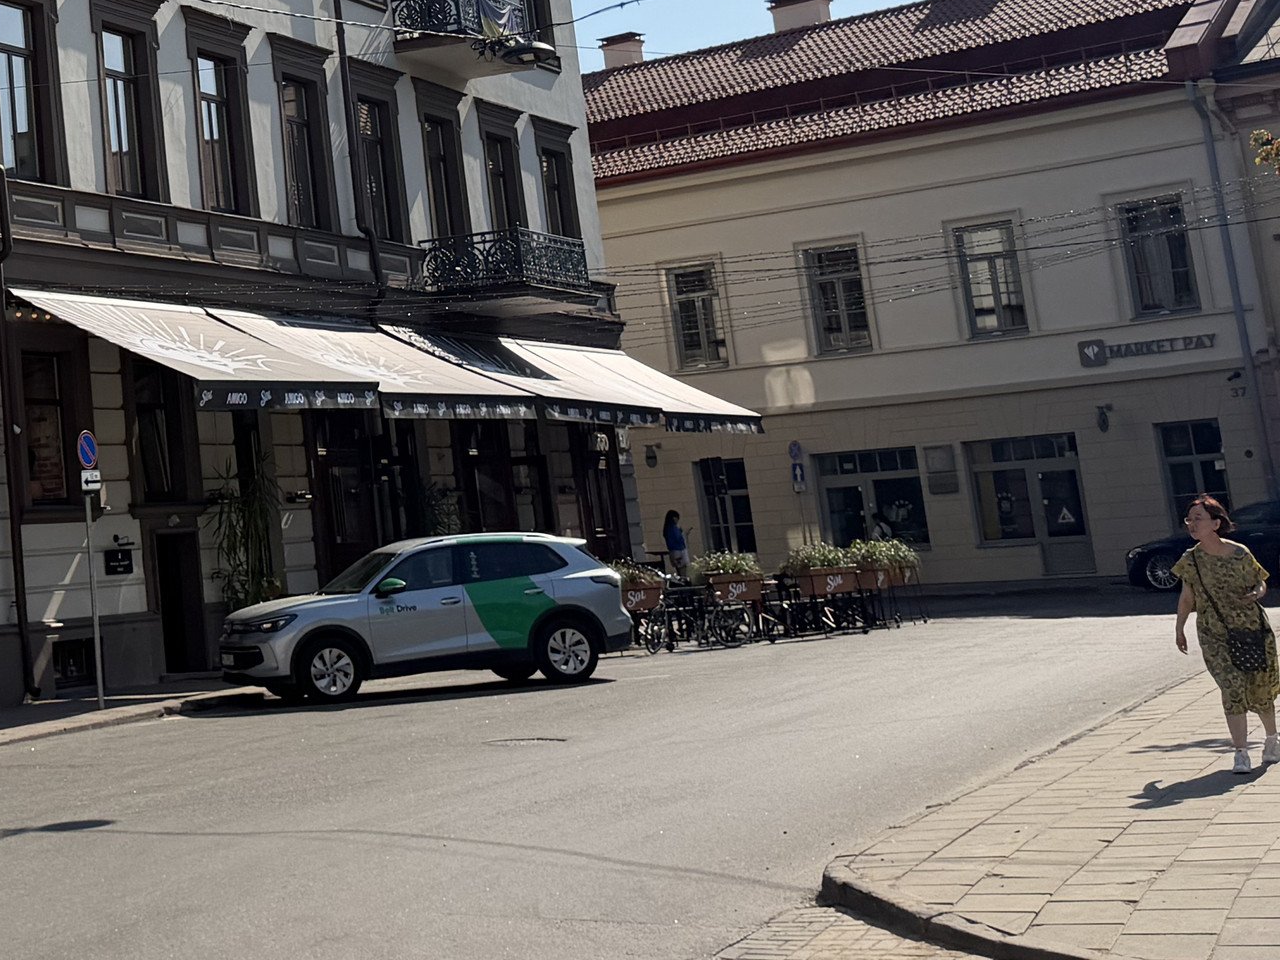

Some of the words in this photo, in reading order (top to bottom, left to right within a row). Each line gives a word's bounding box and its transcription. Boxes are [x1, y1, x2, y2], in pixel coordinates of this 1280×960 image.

[1109, 338, 1177, 359] MARKET
[1182, 333, 1216, 351] PAY
[1230, 386, 1247, 398] 37
[396, 604, 417, 613] Drive
